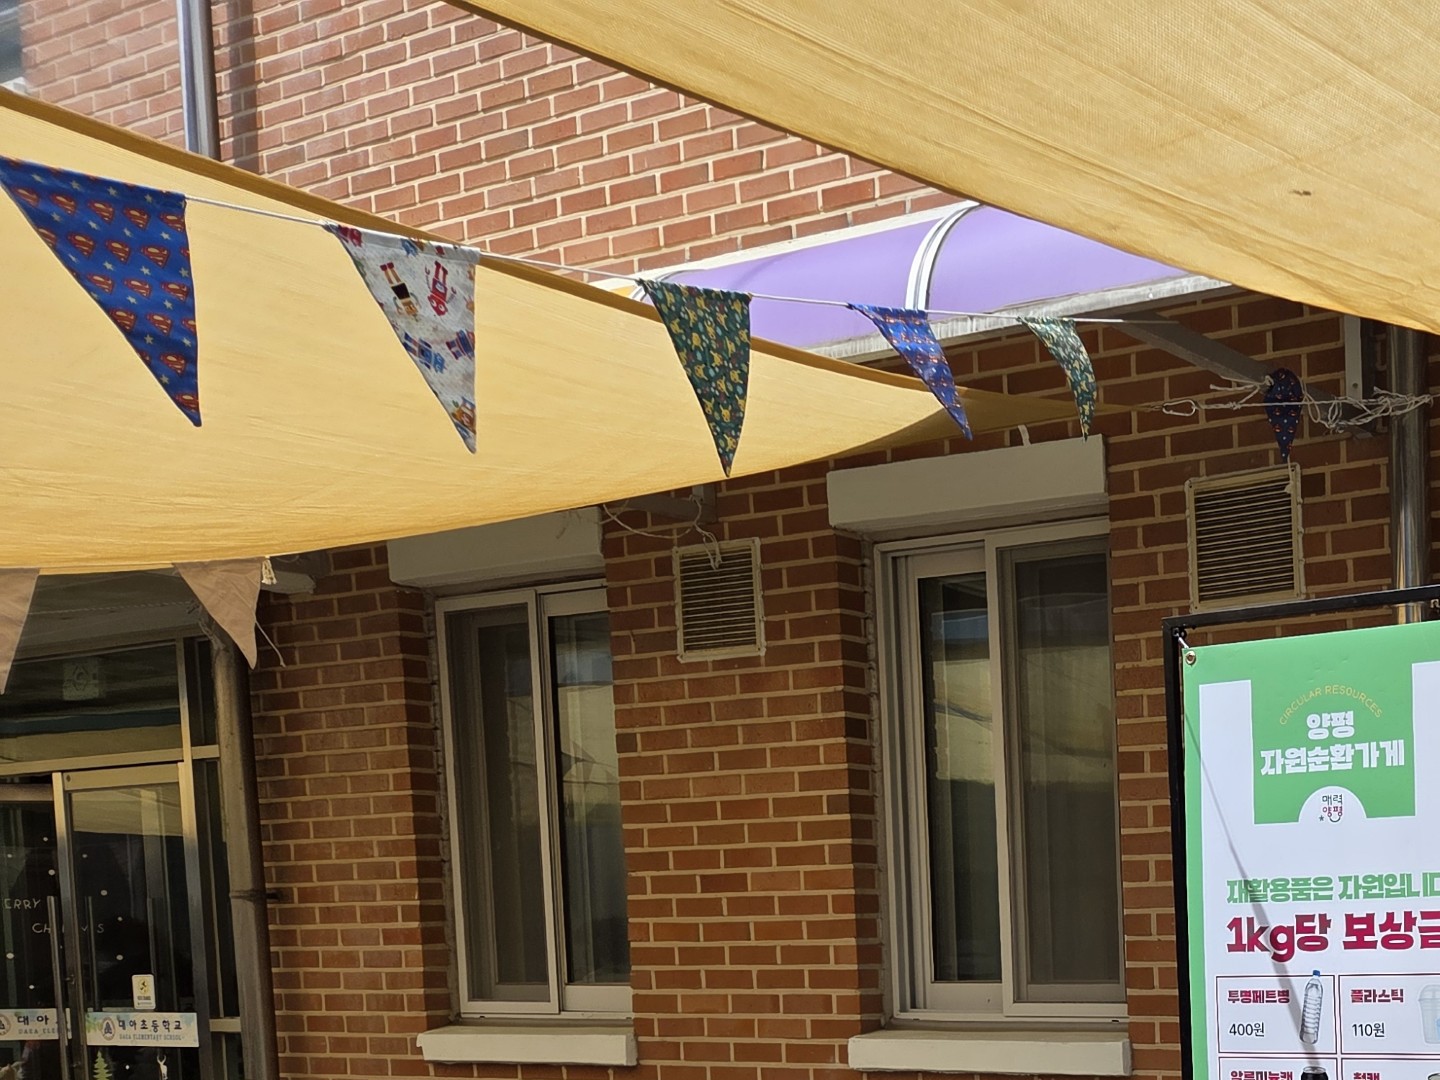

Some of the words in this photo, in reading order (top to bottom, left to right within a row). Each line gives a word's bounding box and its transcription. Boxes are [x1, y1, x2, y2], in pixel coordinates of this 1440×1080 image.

[1279, 687, 1322, 725] CIRCULAR
[1324, 684, 1383, 718] RESOURCES
[1306, 710, 1355, 740] 양평
[1260, 739, 1405, 776] 자원순환가게
[1322, 794, 1343, 806] 매력
[1322, 805, 1343, 818] 양평
[1226, 876, 1334, 904] 재활용품은
[4, 898, 41, 909] ERRY
[1226, 912, 1332, 962] 1kg당
[1227, 988, 1291, 1004] 투명페트병
[1351, 988, 1404, 1003] 플라스틱
[118, 1019, 182, 1033] 대아초등학교
[1229, 1022, 1265, 1038] 400원
[1352, 1022, 1385, 1038] 110원
